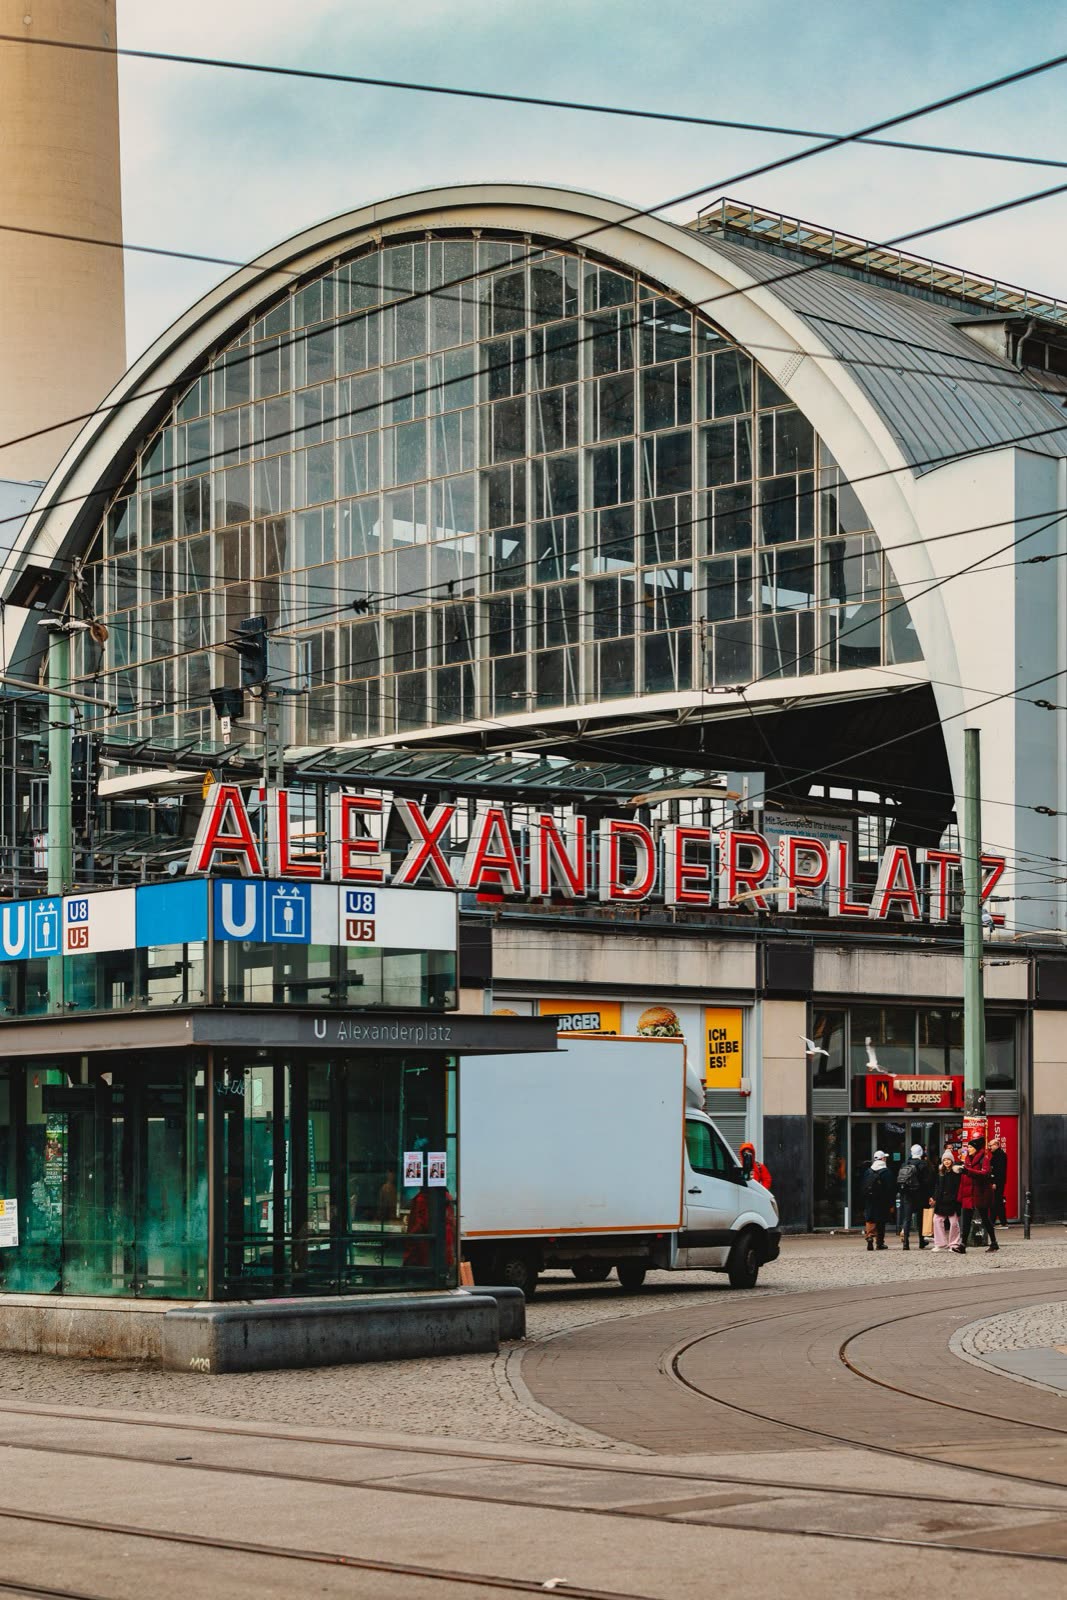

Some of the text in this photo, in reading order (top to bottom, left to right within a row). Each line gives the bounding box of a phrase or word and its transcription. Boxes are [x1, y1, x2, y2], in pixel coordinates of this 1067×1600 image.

[70, 901, 87, 920] U8
[222, 883, 256, 937] U
[349, 894, 373, 912] U8
[3, 906, 25, 956] U
[70, 929, 87, 947] U5
[349, 921, 373, 939] U5
[314, 1019, 451, 1044] U Alexanderplatz
[557, 1014, 600, 1031] URGER
[709, 1029, 727, 1041] ICH
[709, 1041, 739, 1054] LIEBE
[709, 1056, 727, 1068] ES!
[906, 1094, 941, 1103] EXPRESS
